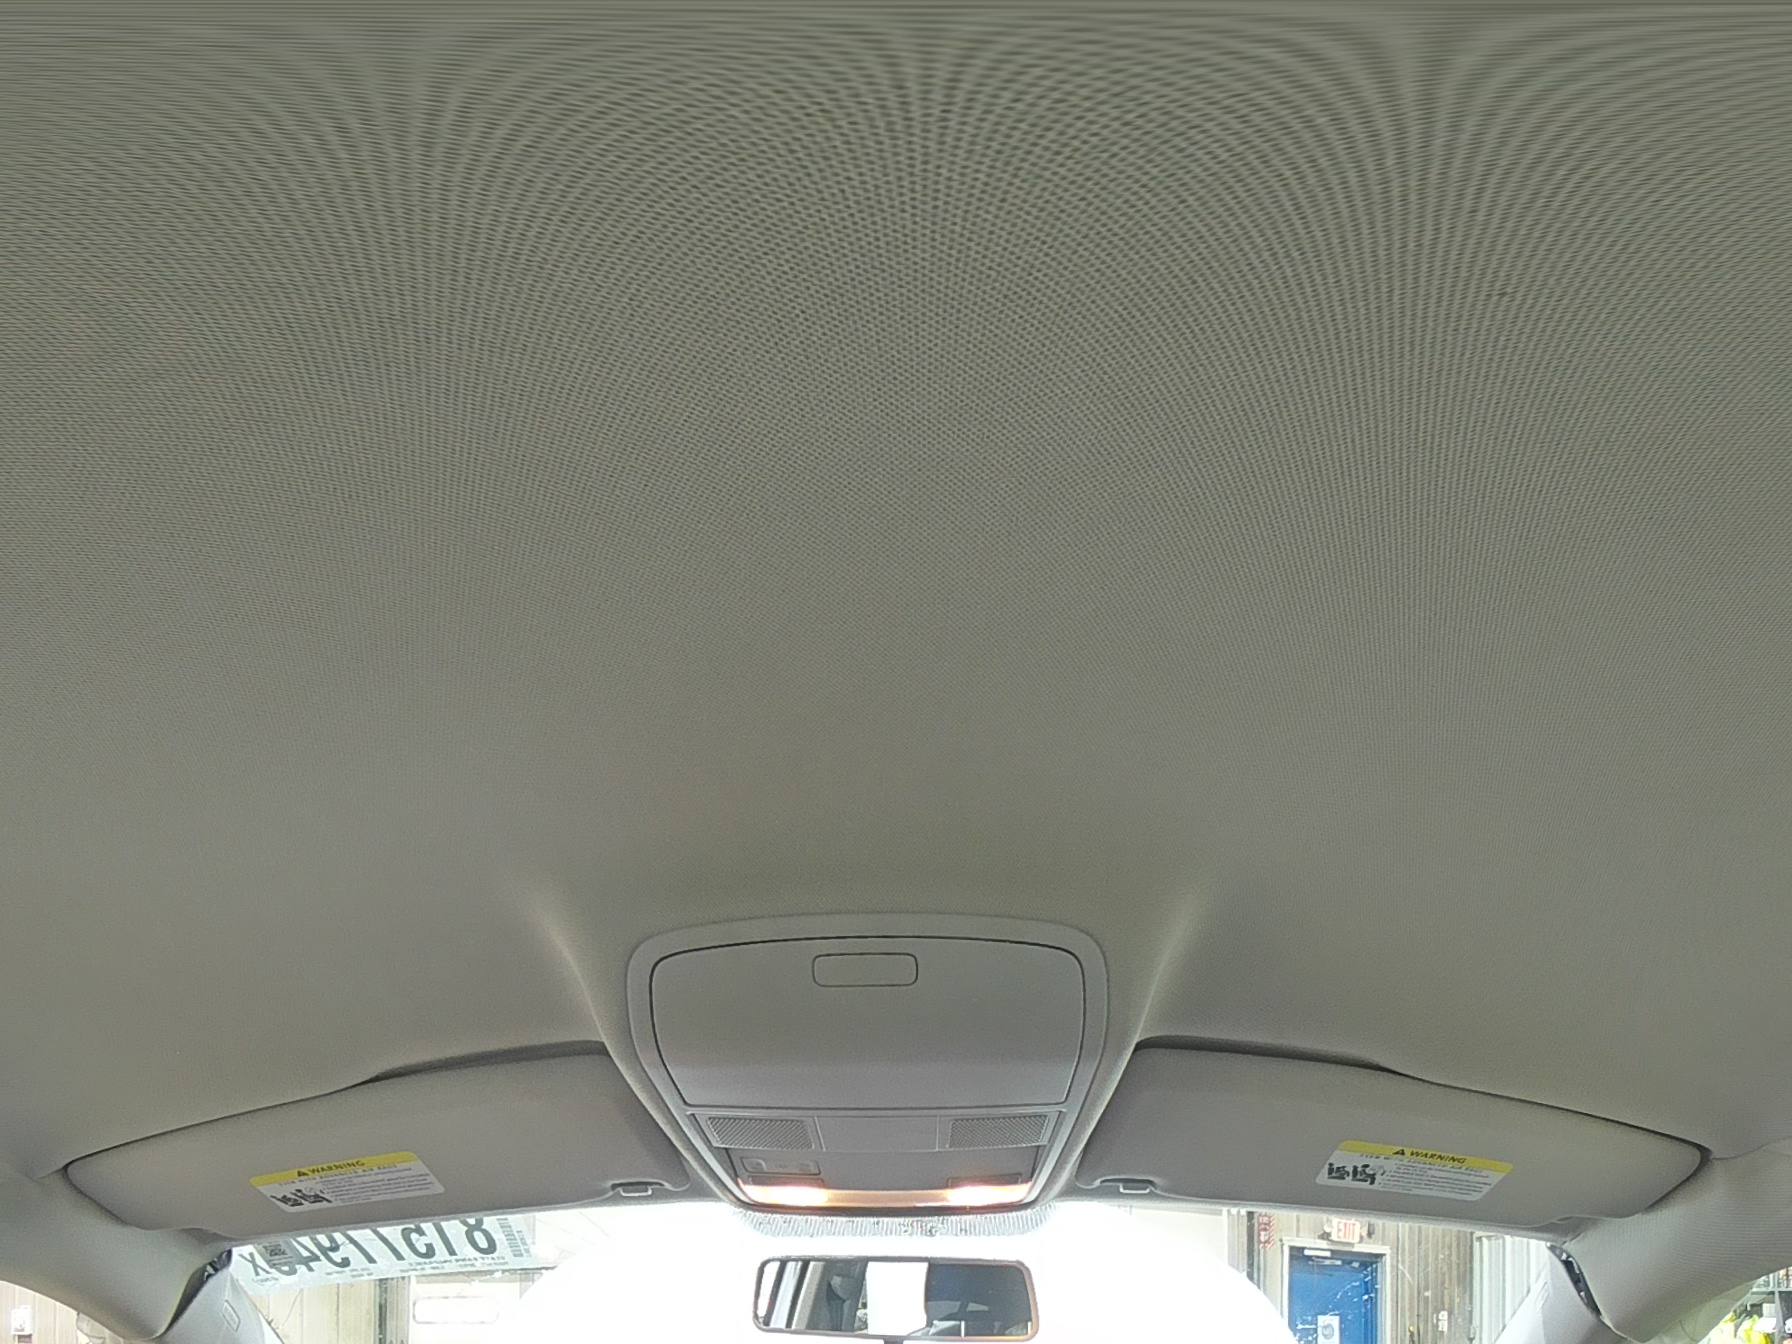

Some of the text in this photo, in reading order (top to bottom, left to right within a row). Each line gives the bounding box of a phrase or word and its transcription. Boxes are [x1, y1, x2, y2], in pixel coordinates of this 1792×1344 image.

[1410, 1150, 1467, 1165] WARNING
[309, 1160, 366, 1176] WARNING
[1336, 1221, 1357, 1240] EXIT
